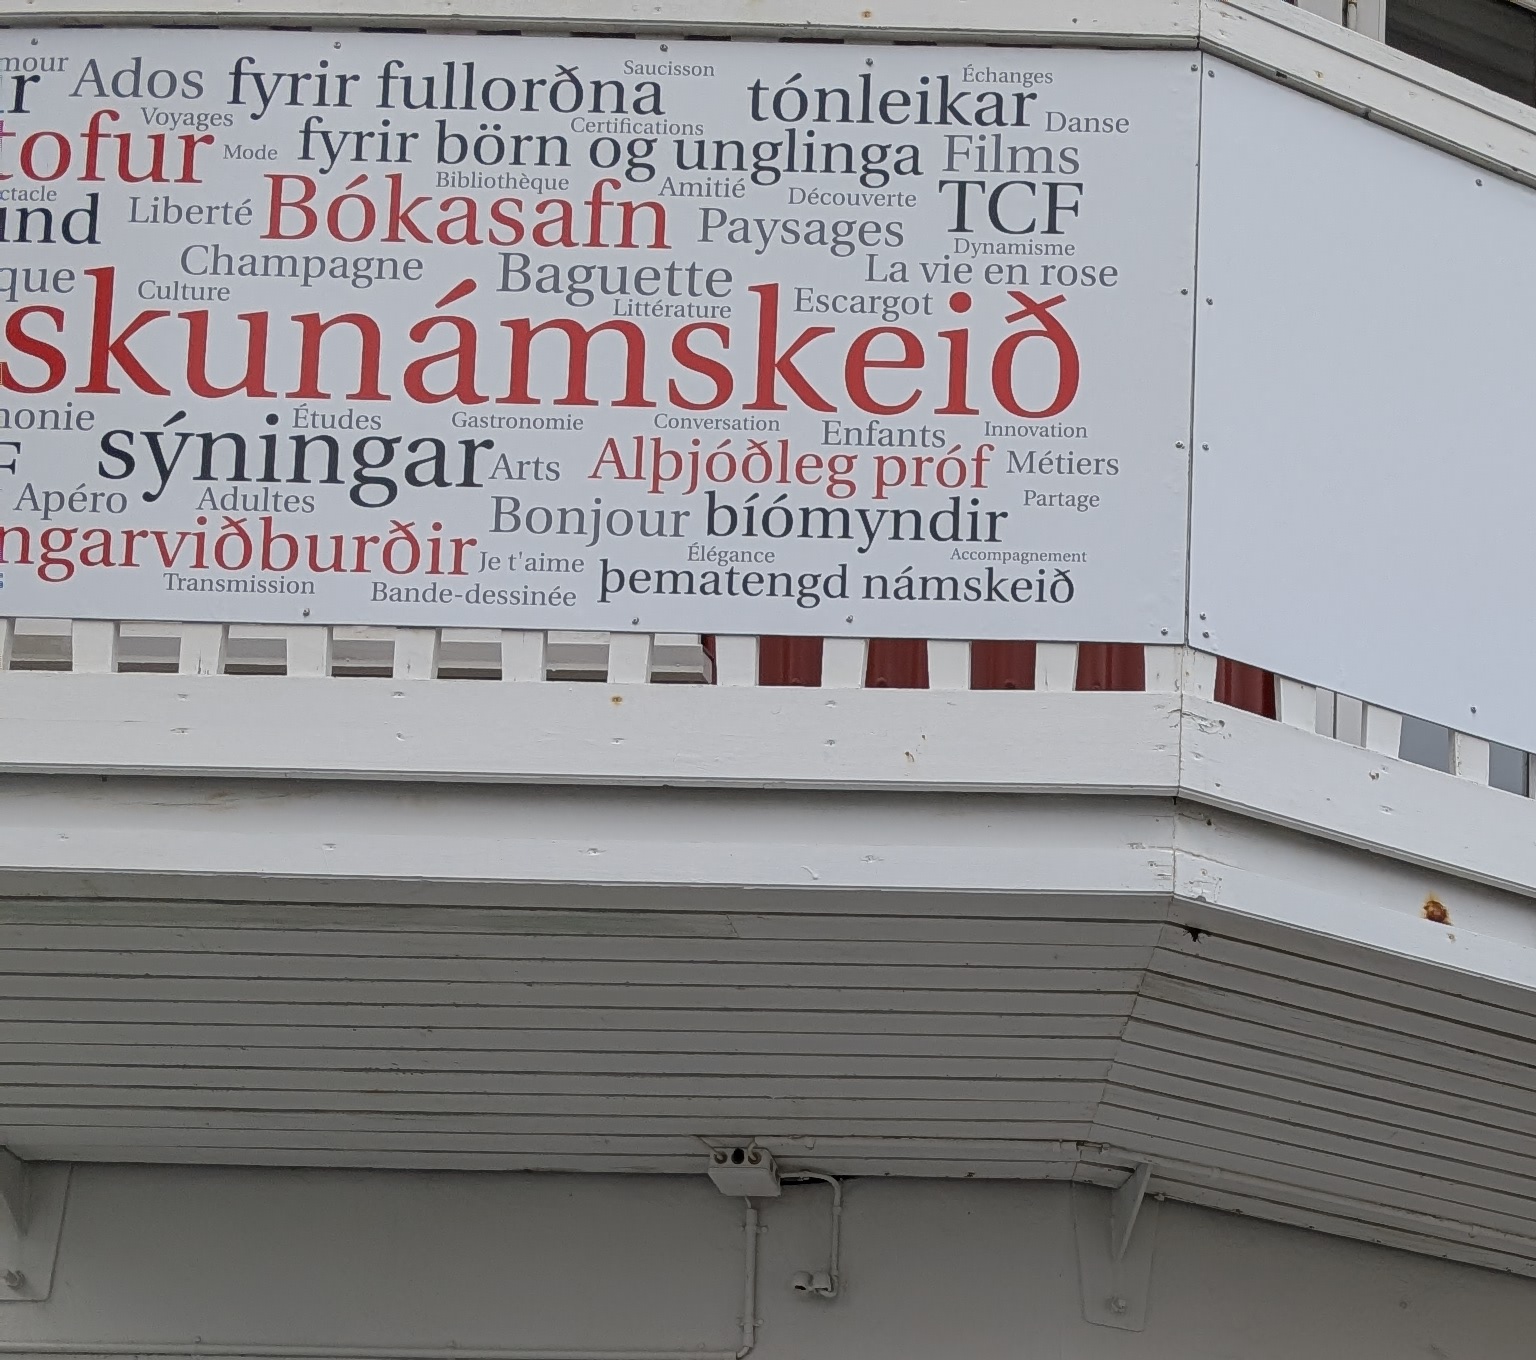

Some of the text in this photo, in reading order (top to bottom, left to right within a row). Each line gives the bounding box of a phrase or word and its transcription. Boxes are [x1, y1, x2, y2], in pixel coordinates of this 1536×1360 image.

[69, 57, 204, 100] Ados
[623, 59, 715, 77] Saucisson
[962, 65, 1053, 88] Échanges
[229, 56, 665, 121] fyrir fullorðna
[747, 72, 1038, 128] tónleikar
[141, 107, 234, 131] Voyages
[570, 116, 704, 136] Certifications
[1045, 111, 1130, 134] Danse
[222, 143, 278, 161] Mode
[298, 116, 924, 188] fyrir börn og unglinga
[943, 134, 1081, 175] Films
[436, 171, 570, 193] Bibliothèque
[658, 176, 746, 199] Amitié
[128, 196, 254, 227] Liberté
[260, 173, 672, 249] Bókasafn
[788, 187, 917, 208] Découverte
[939, 179, 1083, 235] TCF
[697, 206, 905, 257] Paysages
[954, 237, 1075, 259] Dynamisme
[180, 244, 423, 289] Champagne
[496, 251, 733, 307] Baguette
[865, 253, 1118, 288] La vie en rose
[137, 280, 231, 302] Culture
[793, 287, 934, 322] Escargot
[612, 298, 732, 319] Littérature
[0, 266, 1080, 419] skunámskeið
[292, 403, 382, 431] Études
[451, 411, 584, 432] Gastronomie
[653, 412, 780, 433] Conversation
[984, 421, 1088, 440] Innovation
[821, 419, 946, 449] Enfants
[98, 411, 495, 508] sýningar
[488, 453, 561, 482] Arts
[587, 435, 995, 500] Alþjóðleg próf
[1005, 449, 1120, 476] Métiers
[14, 482, 128, 520] Apéro
[196, 486, 316, 514] Adultes
[1023, 488, 1100, 509] Partage
[489, 495, 690, 547] Bonjour
[705, 490, 1009, 554] bíómyndir
[477, 550, 585, 574] Je t'aime
[687, 542, 775, 567] Élégance
[950, 547, 1087, 565] Accompagnement
[163, 573, 315, 596] Transmission
[371, 581, 577, 607] Bande-dessinée
[598, 557, 1075, 609] þematengd námskeið
